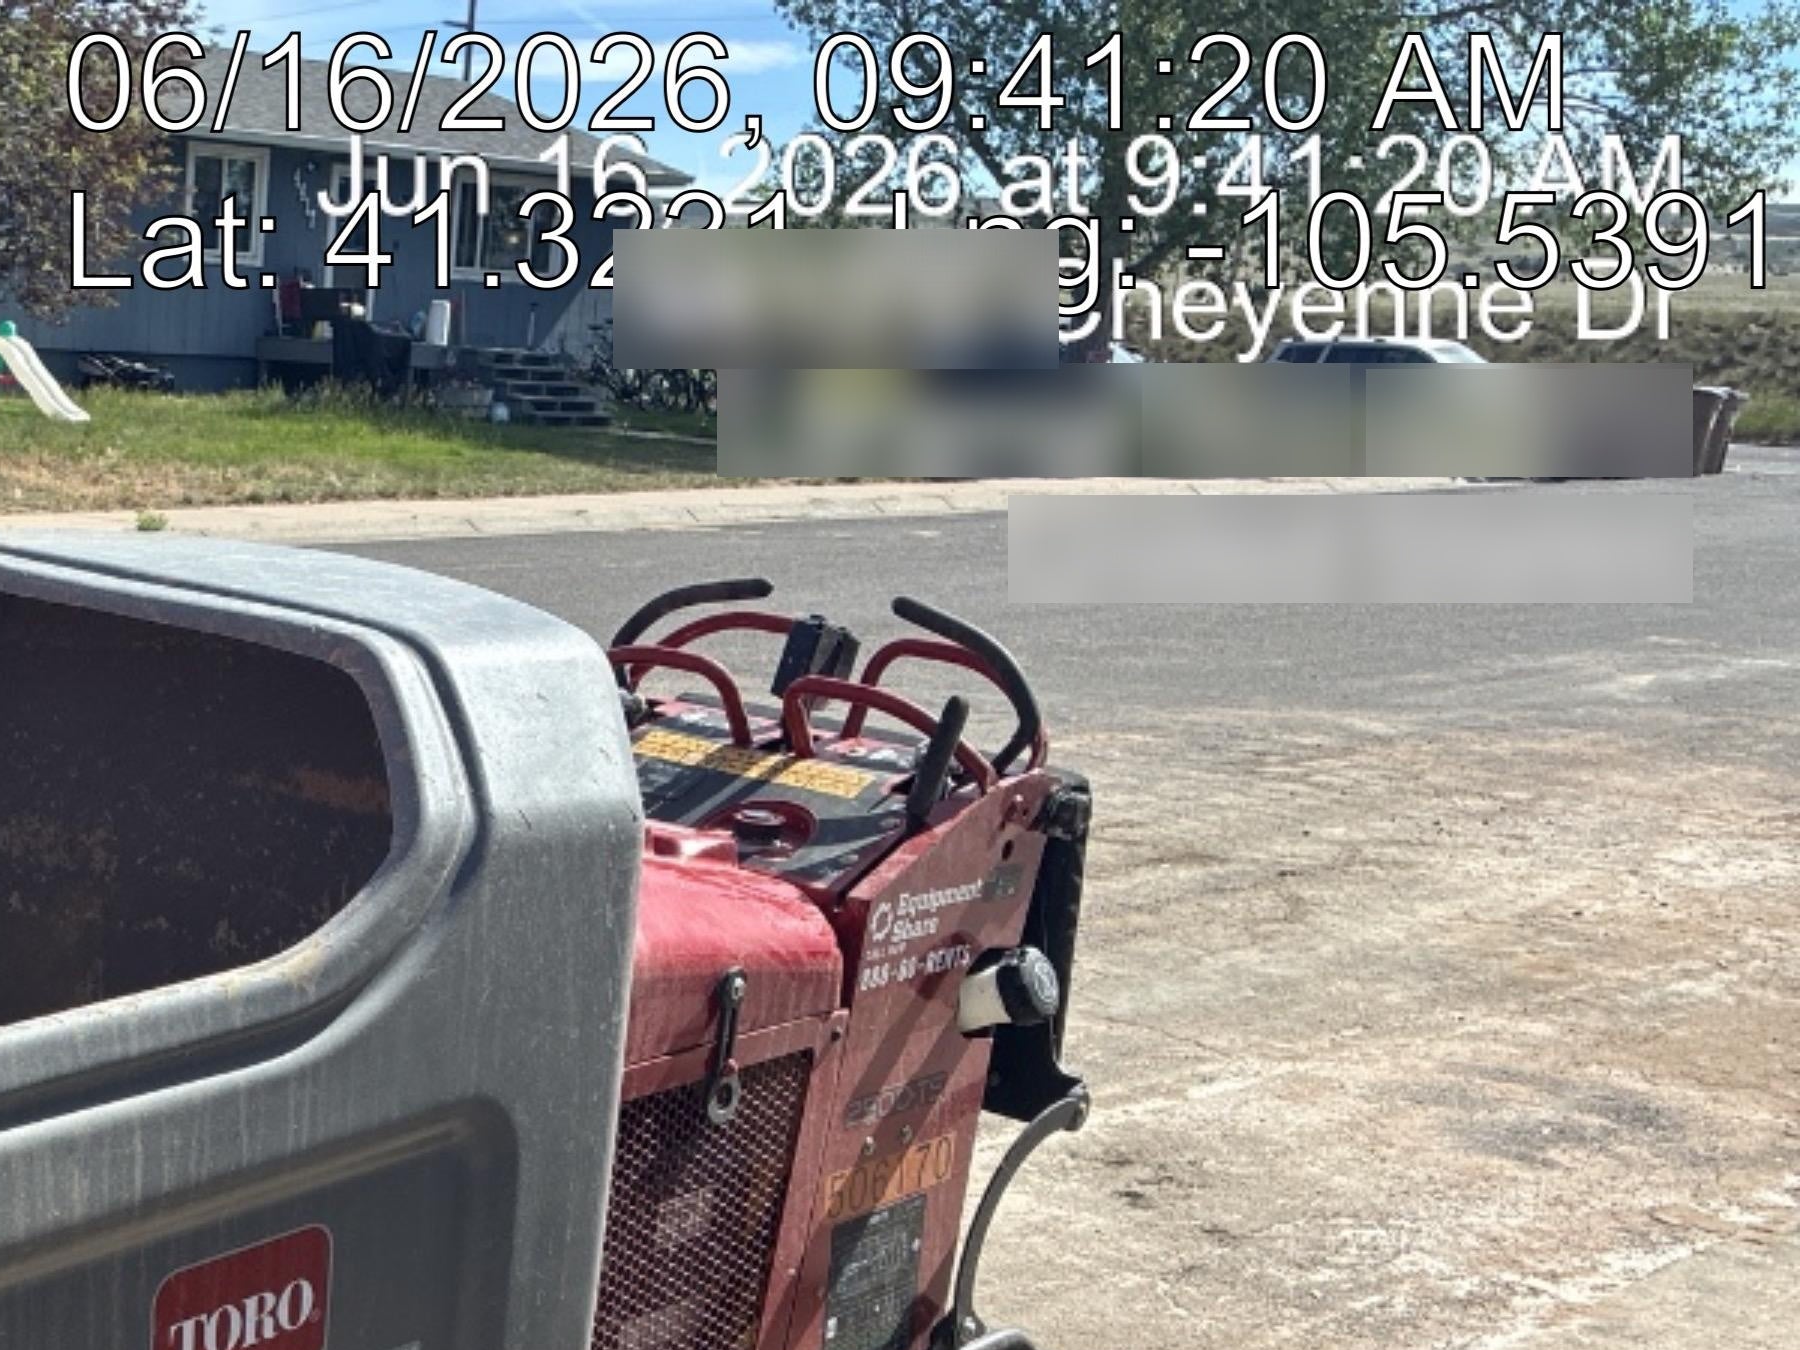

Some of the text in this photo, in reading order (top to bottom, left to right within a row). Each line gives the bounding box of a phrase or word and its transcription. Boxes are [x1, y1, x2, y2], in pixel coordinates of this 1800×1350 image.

[896, 878, 984, 918] Equipment
[890, 917, 940, 943] Share
[827, 1136, 951, 1218] 506170
